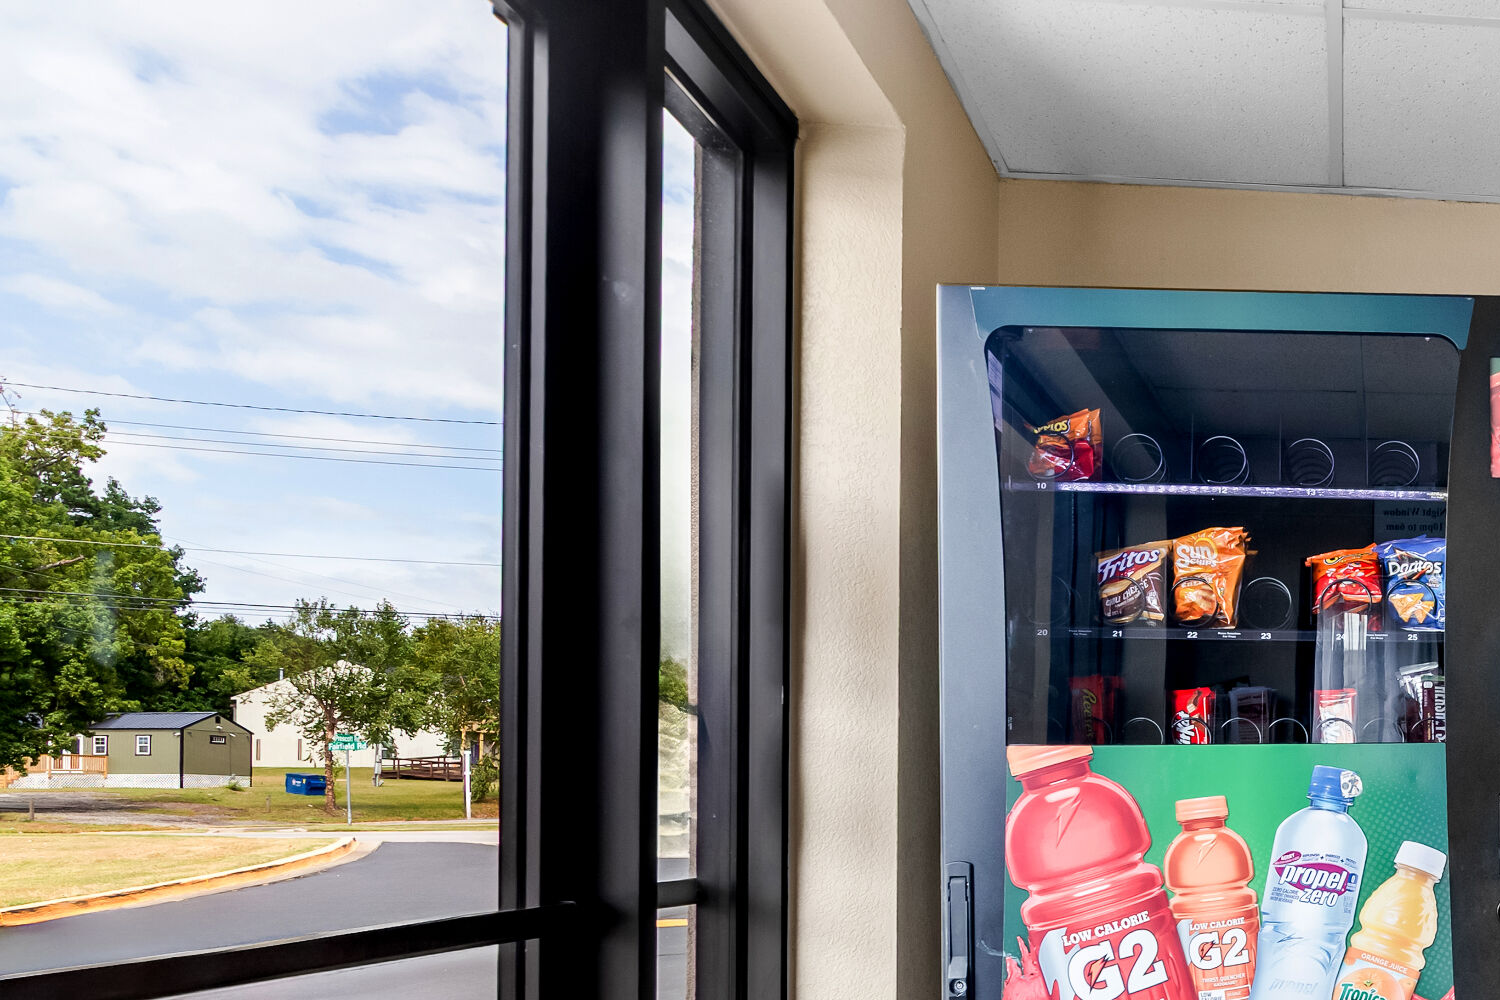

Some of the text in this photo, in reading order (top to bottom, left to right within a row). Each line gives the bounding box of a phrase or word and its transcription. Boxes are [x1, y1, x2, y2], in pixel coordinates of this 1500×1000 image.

[1098, 549, 1160, 585] Fritos
[1388, 561, 1442, 577] Doritos
[1278, 865, 1348, 890] propel
[1300, 888, 1338, 907] zero
[1062, 911, 1150, 947] LOW CALORIE
[1189, 917, 1245, 931] LOW CALORIE
[1189, 928, 1250, 970] G2
[1361, 952, 1408, 974] ORANGE JUICE
